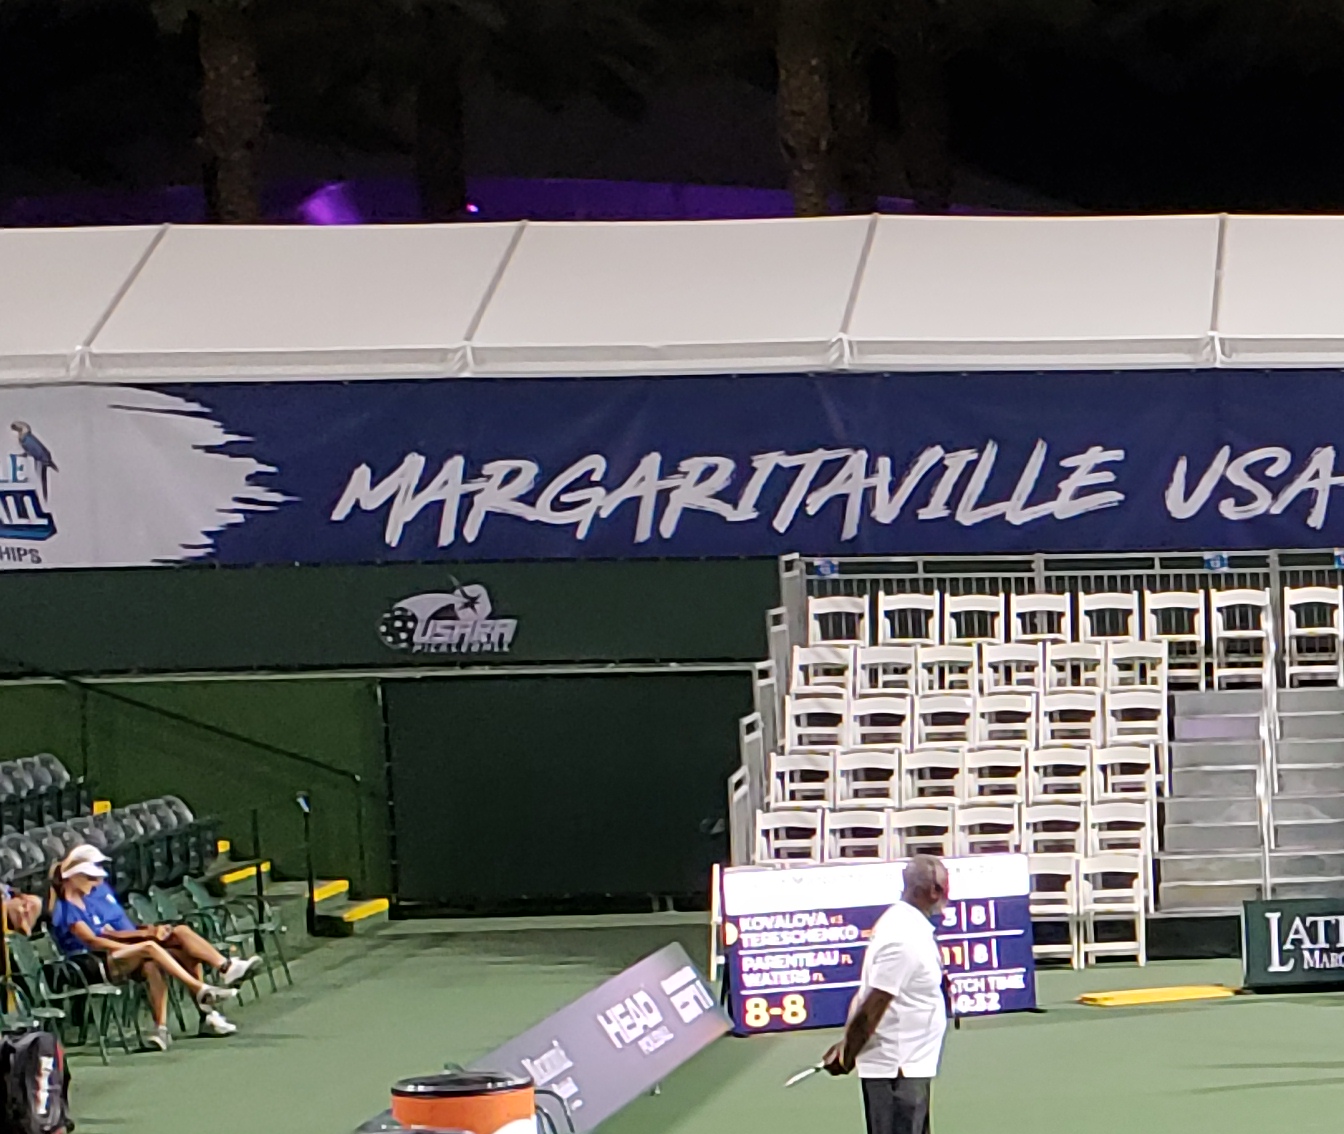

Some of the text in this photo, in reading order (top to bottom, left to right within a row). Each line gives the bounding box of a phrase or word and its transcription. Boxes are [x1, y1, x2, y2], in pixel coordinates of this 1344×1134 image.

[331, 440, 1124, 547] MARGARITAVILLE
[596, 989, 664, 1049] HEAD
[744, 993, 807, 1028] 8-8
